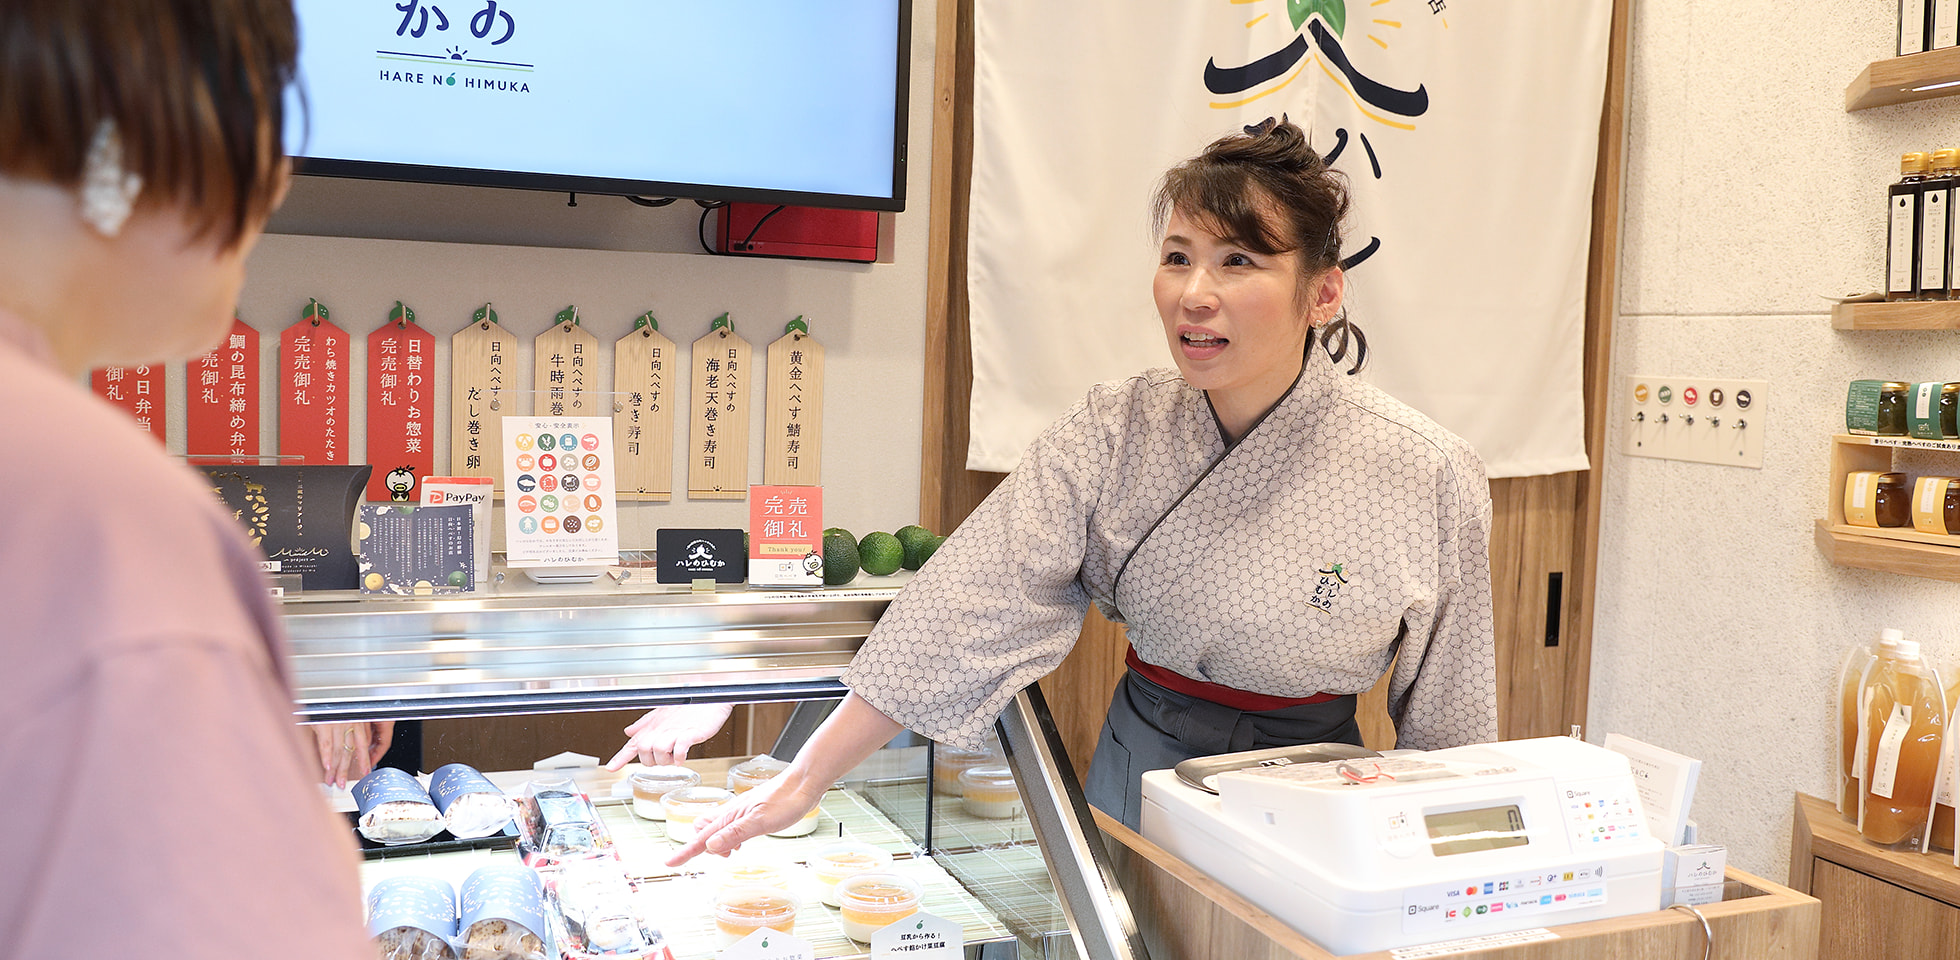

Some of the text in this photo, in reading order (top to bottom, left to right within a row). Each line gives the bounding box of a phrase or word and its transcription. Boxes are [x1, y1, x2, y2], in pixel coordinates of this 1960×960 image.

[380, 70, 424, 84] HARE
[465, 78, 530, 93] HIMUKA
[294, 336, 311, 405] 完売御礼
[325, 336, 336, 461] わら焼きカツオのたたき
[381, 338, 397, 406] 完売御礼
[406, 339, 423, 453] 日替わりお惣菜
[572, 344, 584, 409] 日向へべすの
[650, 348, 662, 413] 日向へべすの
[726, 349, 738, 412] 日向へべすの
[466, 386, 482, 469] だし巻き卵
[704, 358, 720, 469] 海老天巻き寿司
[786, 350, 803, 469] 黄金へべす鯖寿司
[446, 492, 485, 504] PayPay
[763, 519, 808, 538] 御礼
[764, 496, 808, 515] 完売
[676, 559, 726, 567] ハレのひむか
[1310, 576, 1329, 604] ひむか
[1418, 904, 1439, 913] Square
